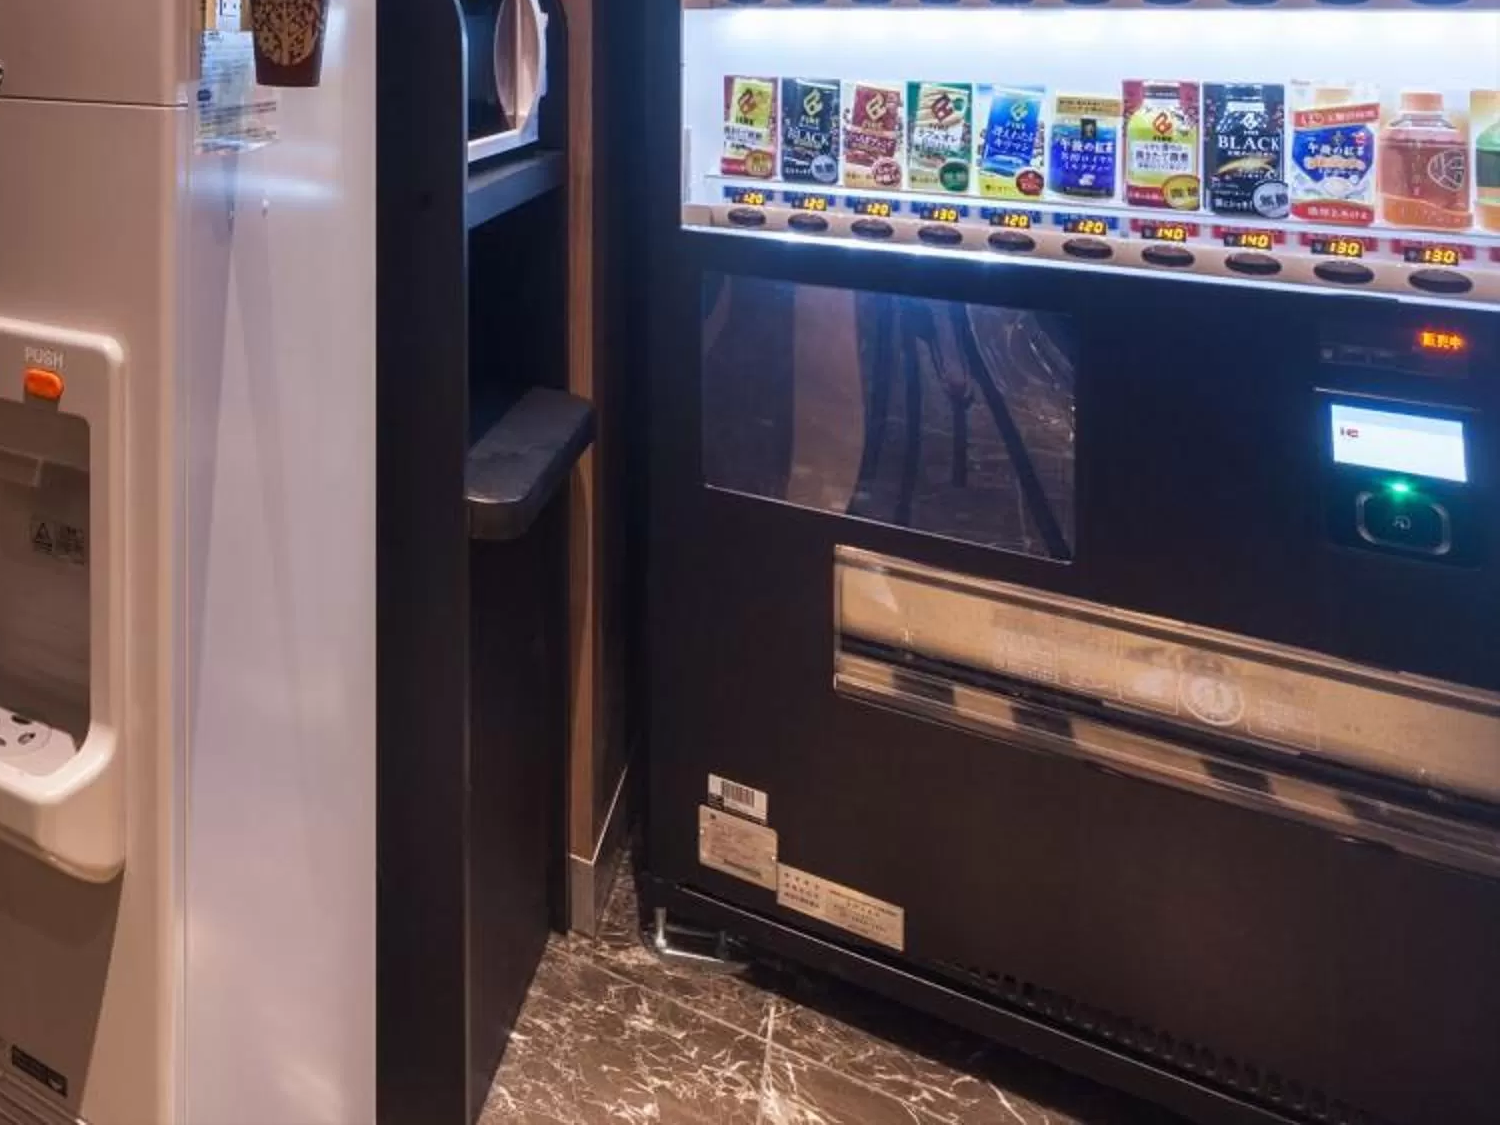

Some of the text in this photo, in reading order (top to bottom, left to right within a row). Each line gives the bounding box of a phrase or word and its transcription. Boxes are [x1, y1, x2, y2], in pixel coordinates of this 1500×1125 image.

[1060, 138, 1113, 153] 午後の紅茶
[1218, 135, 1280, 150] BLACK
[1307, 142, 1364, 156] 午後の紅茶
[1004, 214, 1029, 227] 120
[1078, 221, 1104, 233] 120
[1156, 227, 1183, 240] 140
[1240, 234, 1269, 248] 140
[1329, 241, 1360, 256] 130
[1424, 249, 1455, 263] 130
[24, 346, 64, 367] PUSH
